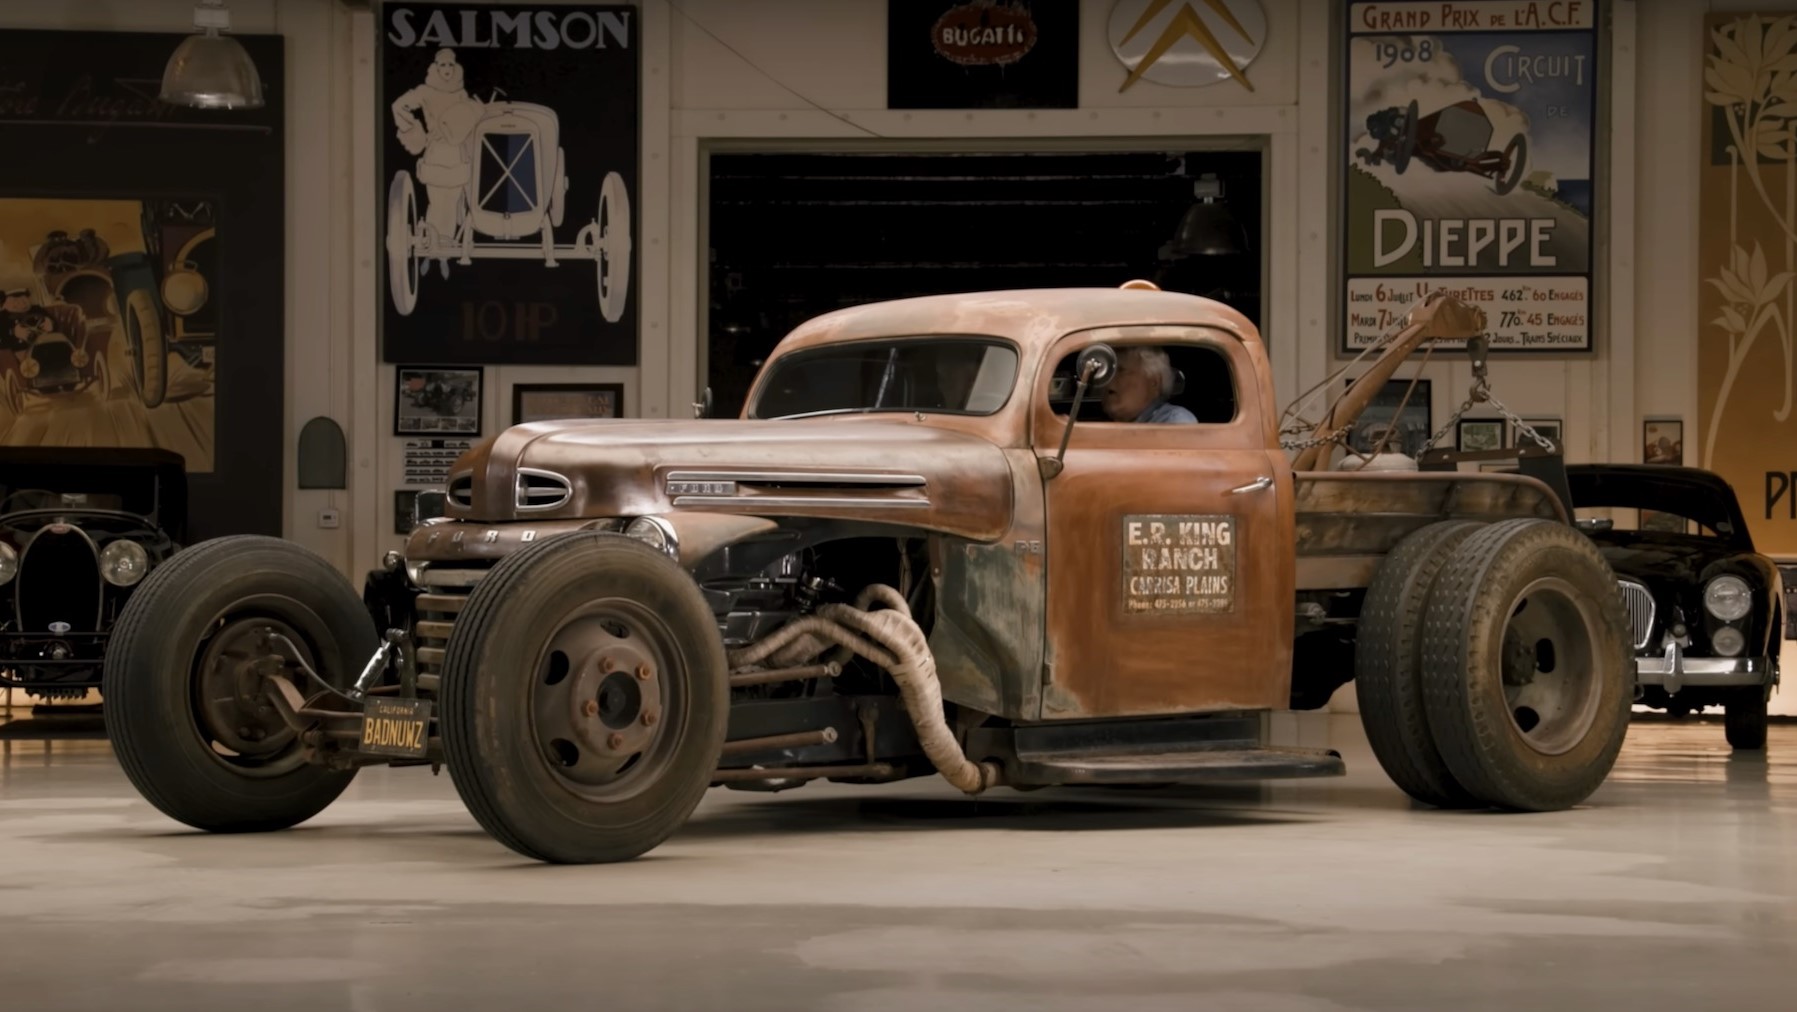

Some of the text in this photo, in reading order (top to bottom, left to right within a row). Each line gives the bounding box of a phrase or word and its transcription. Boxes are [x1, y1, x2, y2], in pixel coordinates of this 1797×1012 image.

[388, 8, 630, 50] SALMSON
[1363, 5, 1431, 30] GRAND
[1441, 4, 1480, 29] PRIX
[1375, 40, 1433, 69] 1908
[1484, 44, 1586, 93] CIRCUIT
[1546, 104, 1568, 119] DE
[1373, 208, 1557, 268] DIEPPE
[1375, 283, 1386, 302] 6
[1532, 288, 1547, 301] 60
[1377, 309, 1387, 330] 7
[1527, 310, 1543, 325] 45
[427, 530, 537, 544] FORD
[1128, 521, 1231, 545] E.R. KING
[1142, 547, 1218, 571] RANCH
[1186, 575, 1228, 595] PLAINS
[379, 705, 415, 715] CALIFORNIA
[363, 717, 424, 749] BADNUWZ
